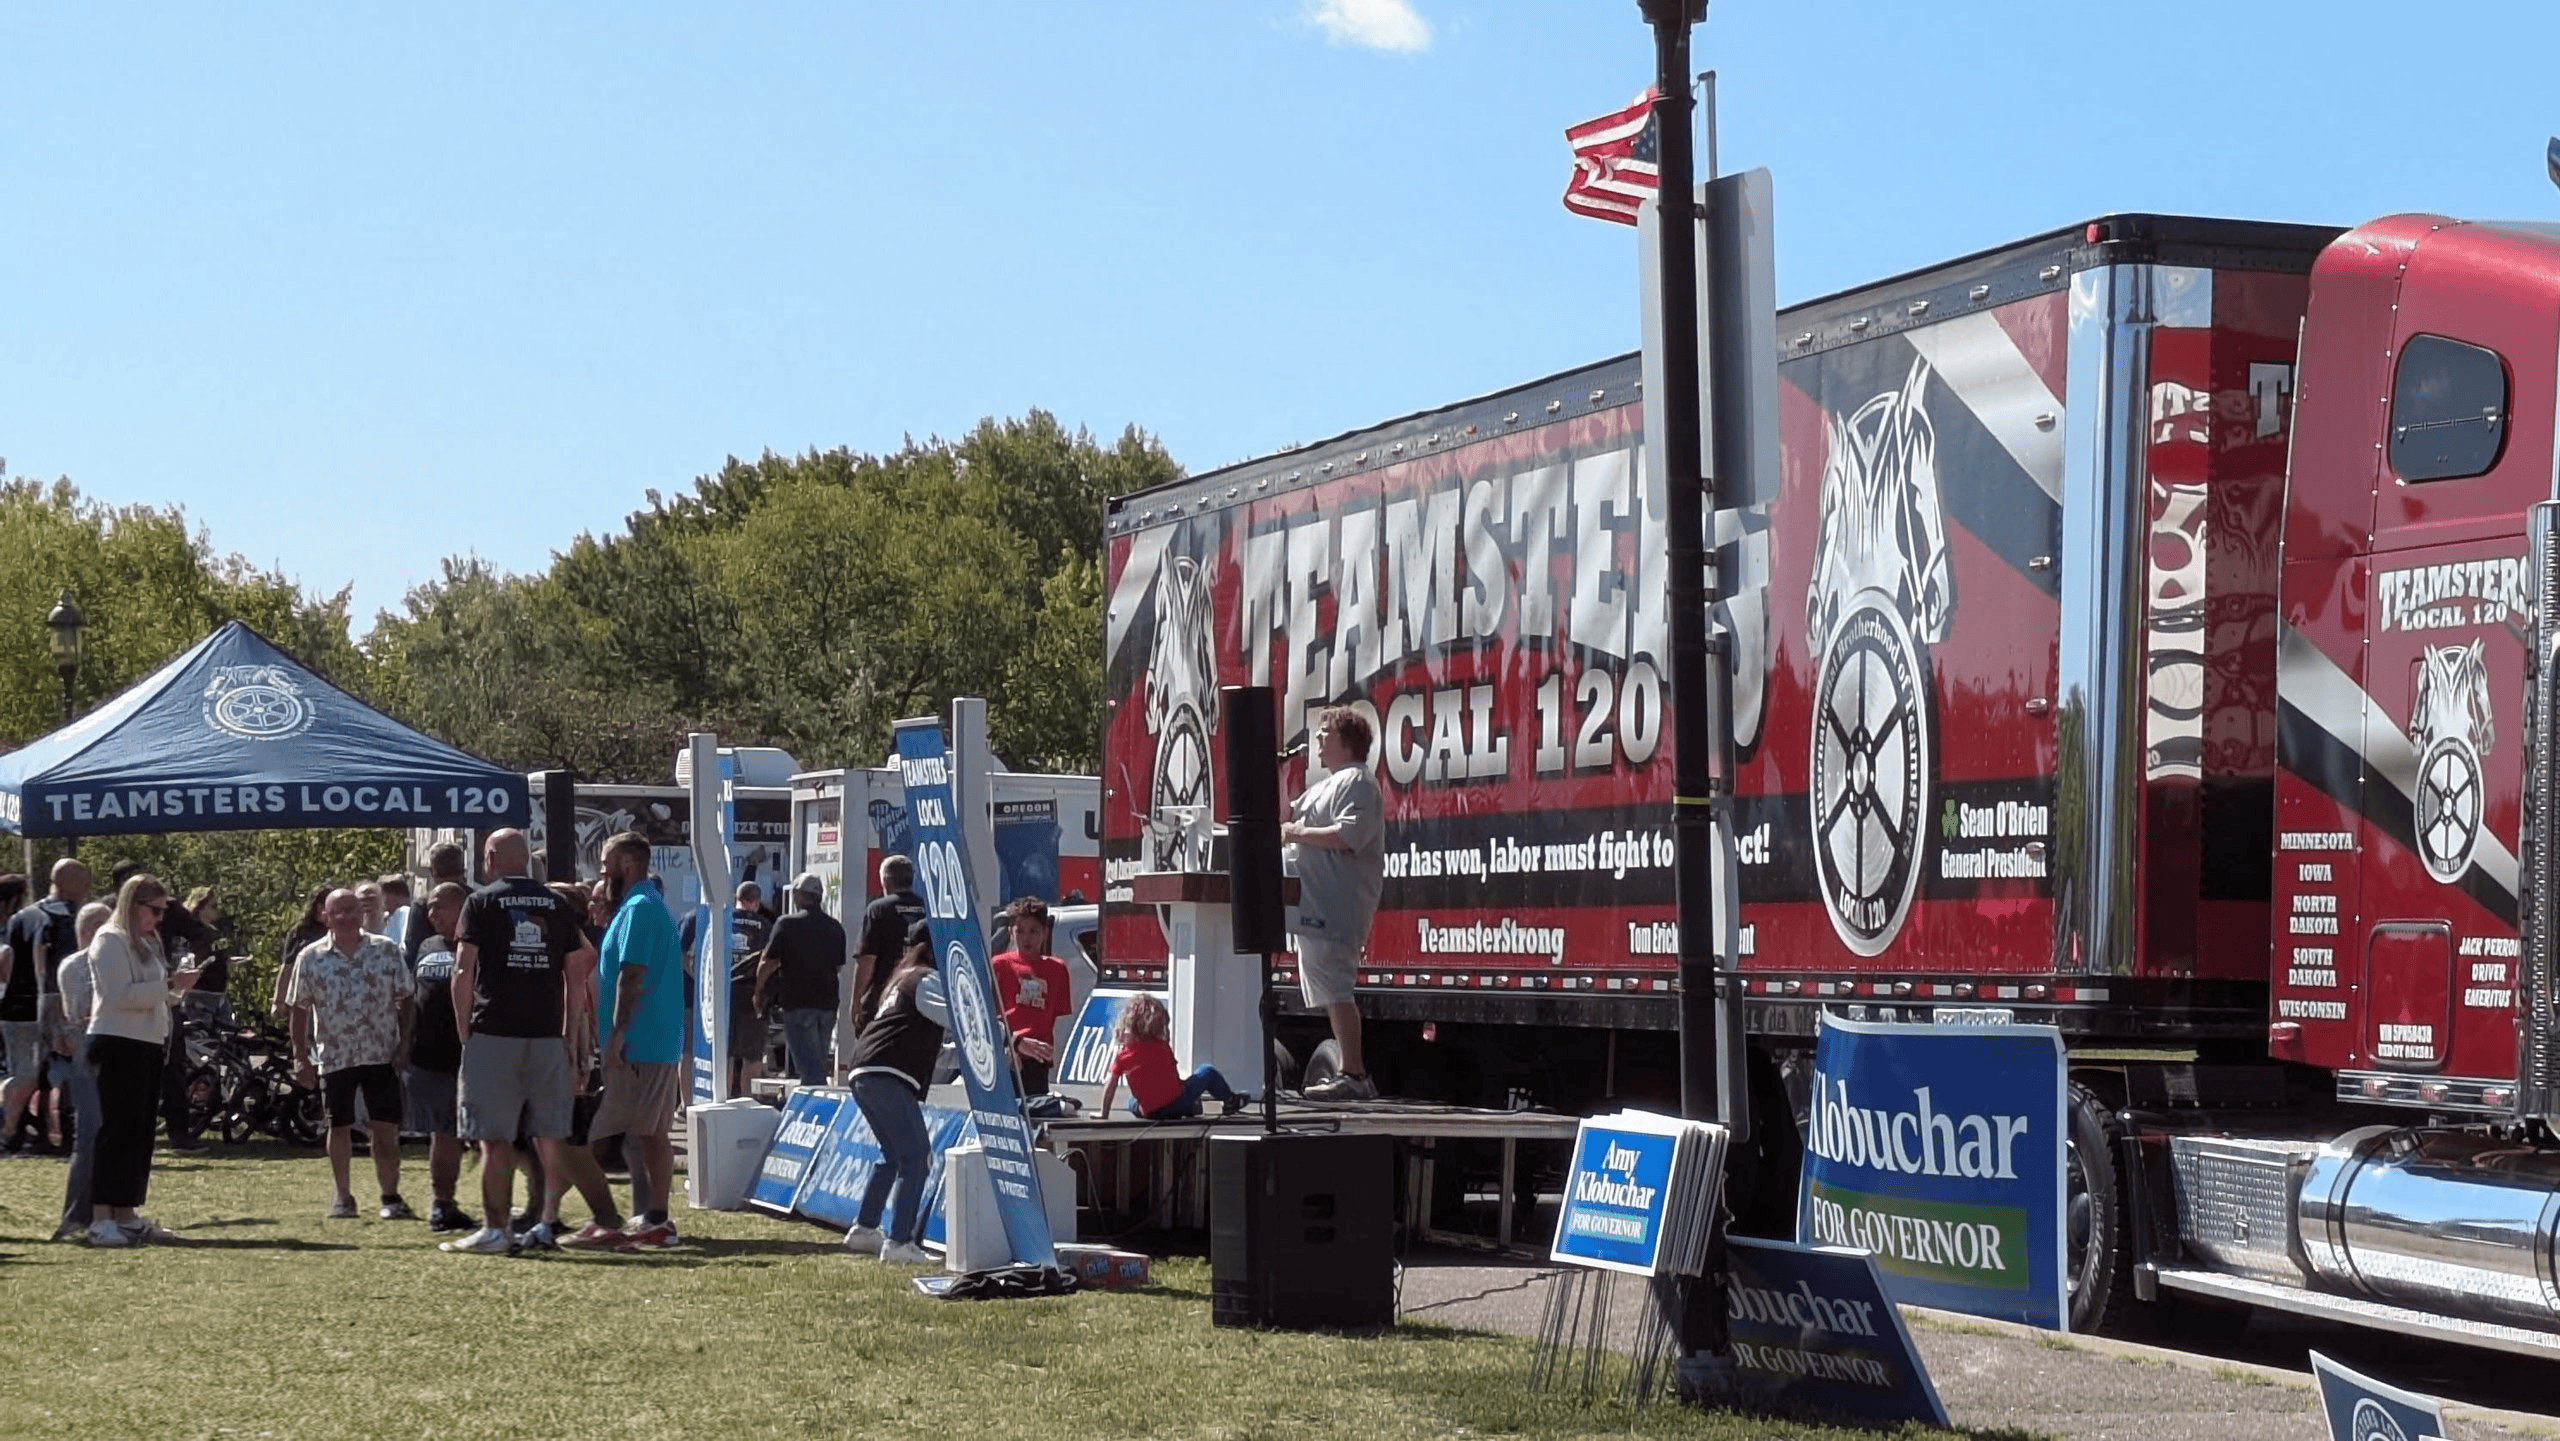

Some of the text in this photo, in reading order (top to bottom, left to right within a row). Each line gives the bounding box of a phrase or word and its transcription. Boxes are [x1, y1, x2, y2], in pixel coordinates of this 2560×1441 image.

[1242, 445, 1769, 750] TEAMSTES
[2401, 601, 2508, 631] LOCAL 120
[1837, 614, 1901, 666] Brotherhood
[1898, 664, 1912, 693] of
[1535, 662, 1661, 773] 120
[902, 757, 947, 788] TEAMSTERS
[46, 785, 510, 821] TEAMSTERS LOCAL 120
[916, 798, 946, 826] LOCAL
[1003, 803, 1050, 814] OREGON
[1960, 801, 2048, 838] Sean O'Brien
[1411, 842, 1442, 876] has
[1445, 849, 1488, 883] won,
[1490, 837, 1540, 873] labor
[1544, 834, 1595, 871] must
[1599, 830, 1650, 880] fight
[1653, 830, 1674, 867] to
[2280, 832, 2354, 850] MINNESOTA
[1941, 847, 2047, 879] General President
[2298, 864, 2333, 882] IOWA
[918, 841, 967, 919] 120
[1839, 886, 1887, 930] LOCAL 120
[2292, 895, 2337, 913] NORTH
[1418, 917, 1565, 965] TeamsterStrong
[1628, 921, 1679, 954] Tom Erick
[2289, 916, 2339, 935] DAKOTA
[2293, 947, 2333, 966] SOUTH
[2459, 936, 2483, 956] JACK
[2288, 968, 2337, 988] DAKOTA
[2472, 963, 2506, 982] DRIVER
[2278, 1000, 2347, 1020] WISCONSIN
[2464, 987, 2511, 1008] EMERITUS
[1808, 1070, 2028, 1180] Klobuchar
[1602, 1138, 1642, 1180] Amy
[1575, 1170, 1656, 1211] Klobuchar
[1571, 1212, 1642, 1239] FOR GOVERNOR
[1812, 1195, 2006, 1271] FOR GOVERNOR
[1728, 1271, 1880, 1337] obuchar
[1759, 1345, 1891, 1388] GOVERNOR
